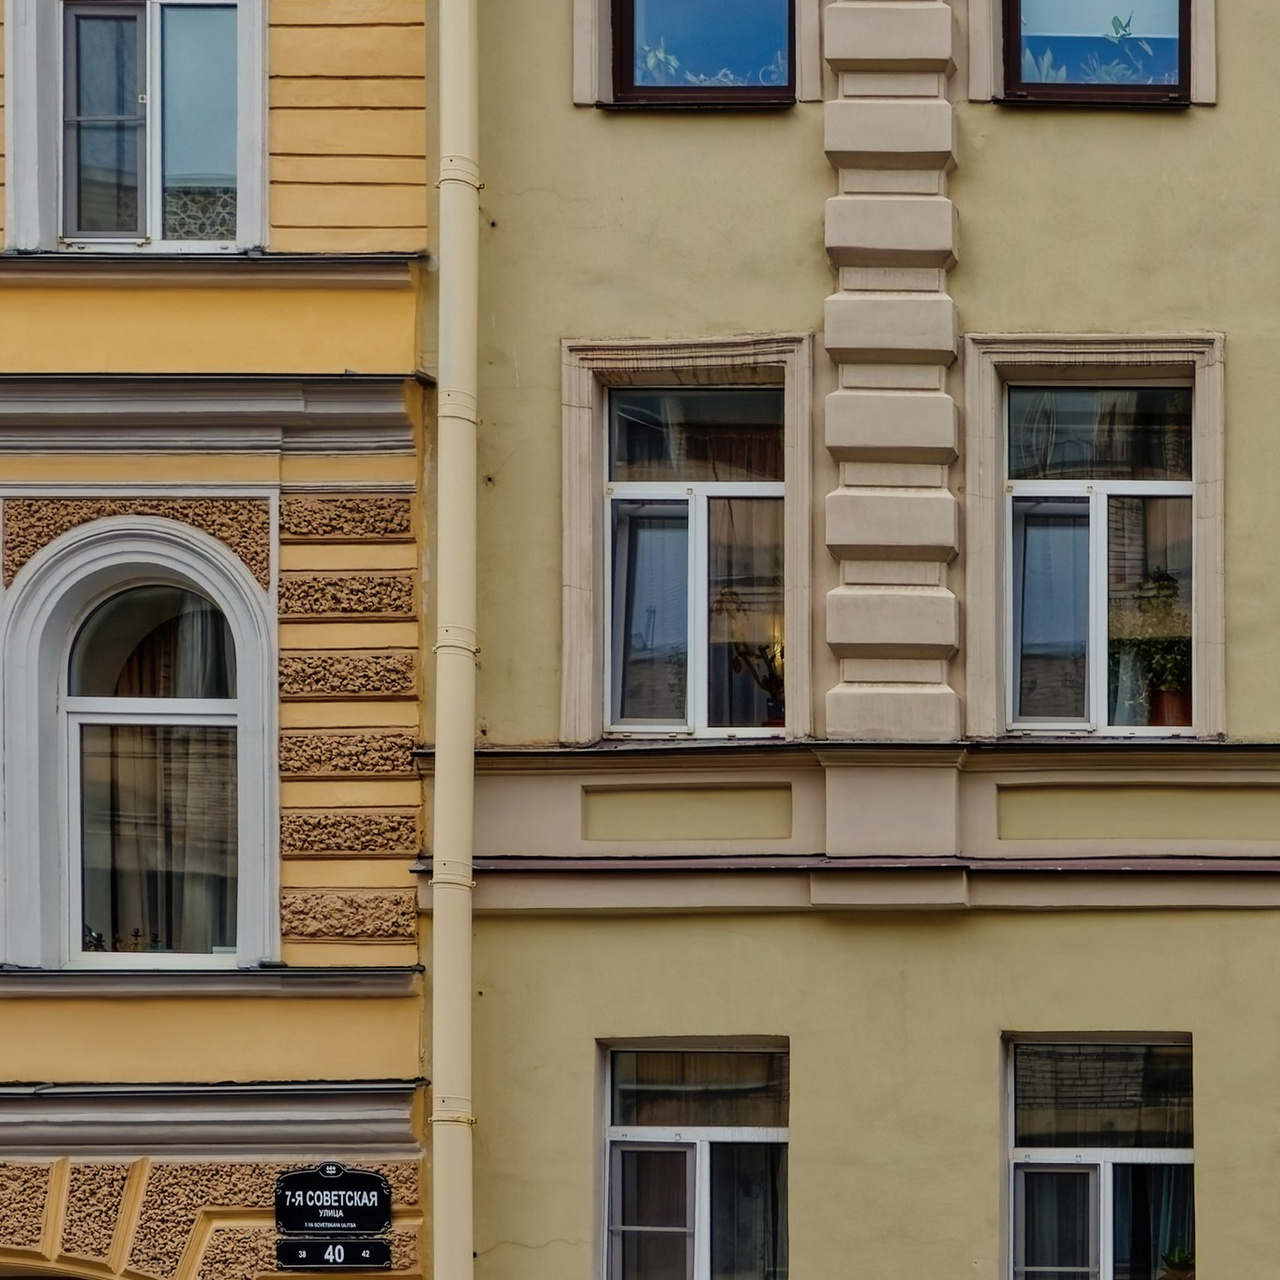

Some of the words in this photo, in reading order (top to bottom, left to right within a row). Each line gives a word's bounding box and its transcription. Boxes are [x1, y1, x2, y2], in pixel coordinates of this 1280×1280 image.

[285, 1191, 303, 1206] 7-Я
[306, 1191, 378, 1206] СОВЕТСКАЯ
[319, 1209, 344, 1218] УЛИЦА
[298, 1250, 307, 1258] 38
[324, 1245, 344, 1263] 40
[361, 1249, 370, 1258] 42
